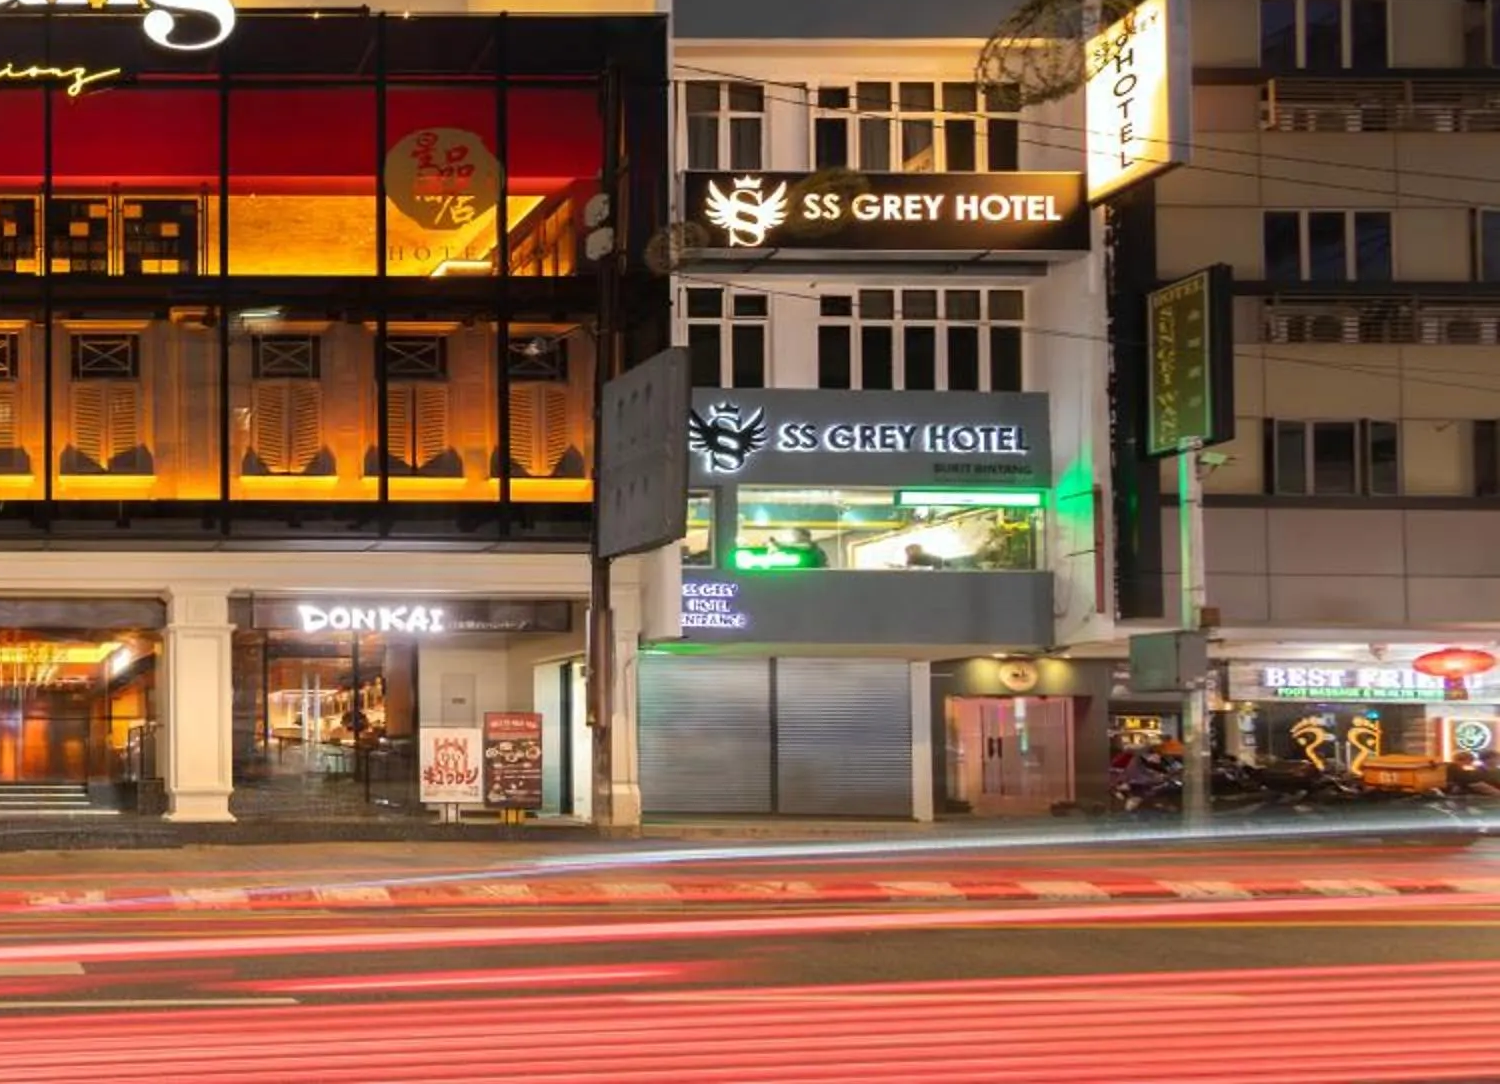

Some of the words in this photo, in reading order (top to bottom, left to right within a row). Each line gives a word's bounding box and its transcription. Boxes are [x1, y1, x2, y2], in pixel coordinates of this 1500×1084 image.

[1113, 48, 1137, 169] HOTEL
[803, 193, 841, 221] SS
[851, 193, 947, 222] GREY
[955, 194, 1062, 222] HOTEL
[778, 423, 818, 451] SS
[824, 423, 917, 452] GREY
[923, 425, 1031, 454] HOTEL
[297, 604, 445, 633] DONKAI
[1264, 666, 1346, 687] BEST
